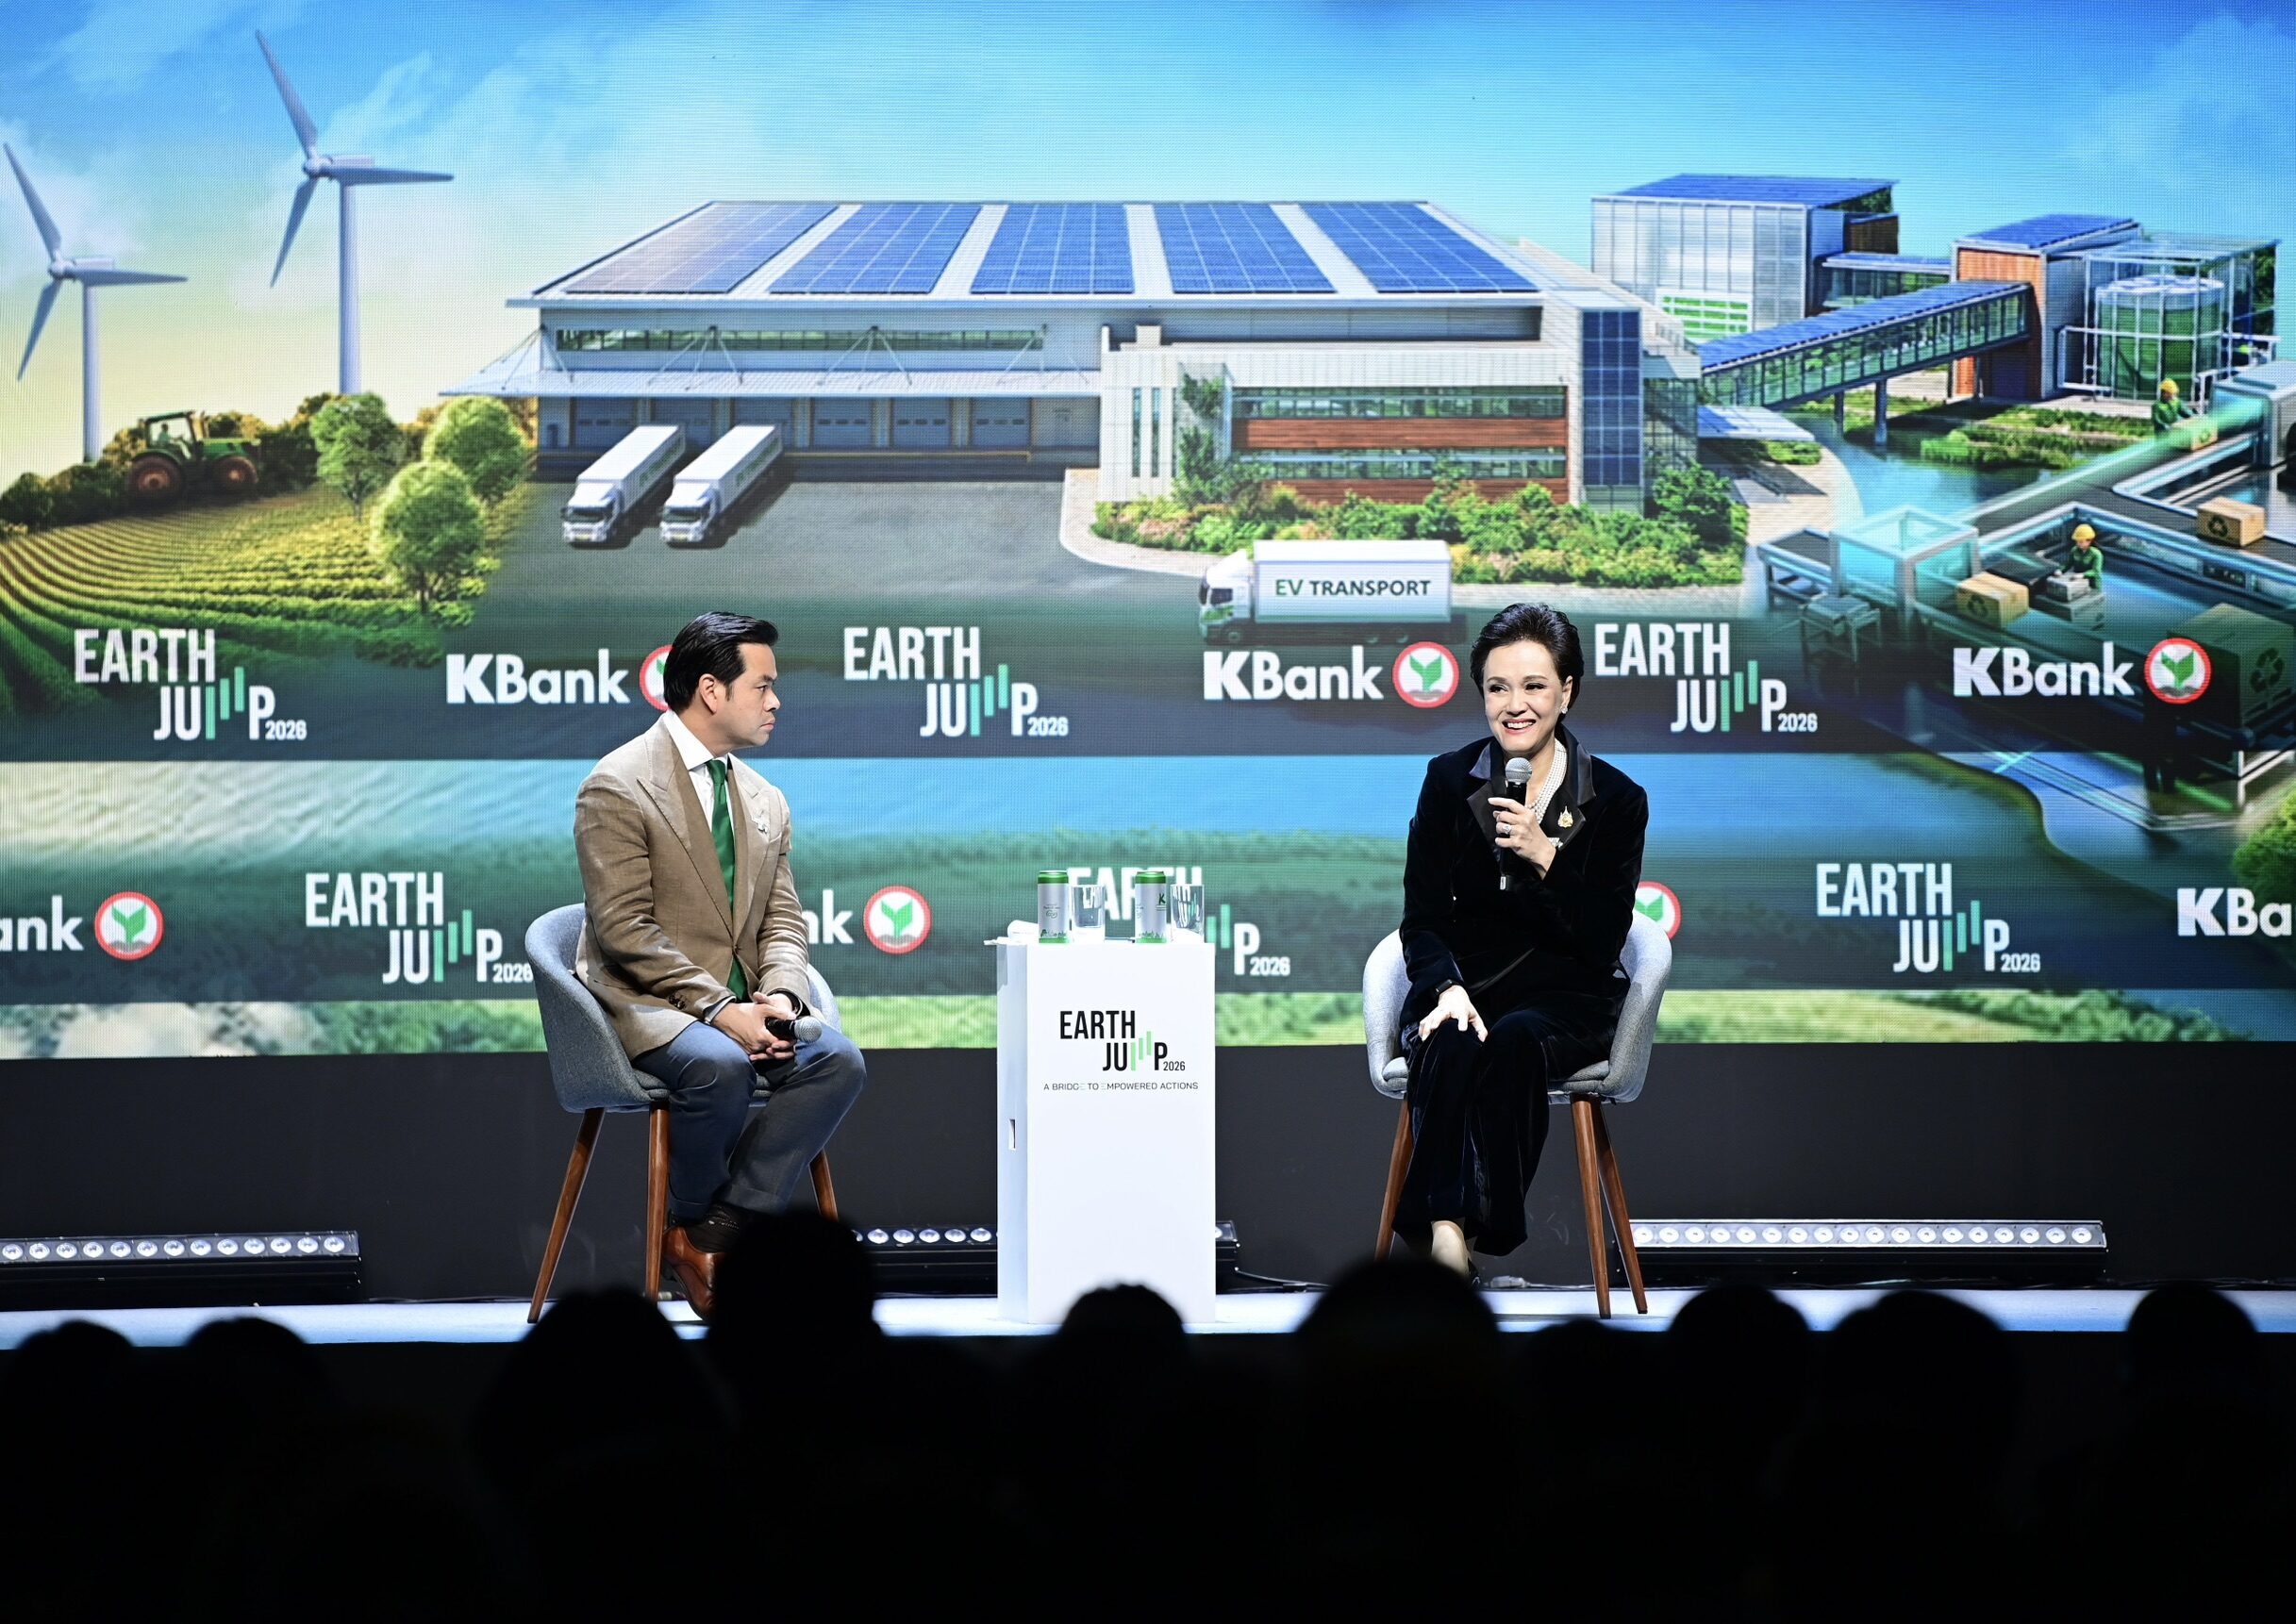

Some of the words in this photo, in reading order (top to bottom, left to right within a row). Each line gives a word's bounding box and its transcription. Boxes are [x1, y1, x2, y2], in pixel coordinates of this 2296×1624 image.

[1276, 579, 1303, 596] EV
[1309, 580, 1431, 596] TRANSPORT
[75, 628, 216, 683] EARTH
[843, 626, 980, 680] EARTH
[1595, 622, 1730, 676] EARTH
[446, 649, 630, 704] KBank
[1204, 645, 1384, 700] KBank
[1953, 641, 2135, 697] KBank
[265, 720, 308, 740] 2026
[1027, 715, 1069, 737] 2026
[1777, 712, 1818, 733] 2026
[305, 872, 443, 927] EARTH
[1816, 863, 1953, 917] EARTH
[2177, 887, 2296, 937] KBa
[492, 962, 534, 983] 2026
[1249, 956, 1291, 977] 2026
[2001, 953, 2040, 972] 2026
[1059, 1010, 1136, 1039] EARTH
[1163, 1060, 1186, 1071] 2026
[1043, 1083, 1050, 1091] A
[1088, 1083, 1100, 1091] TO
[1159, 1082, 1199, 1090] ACTIONS
